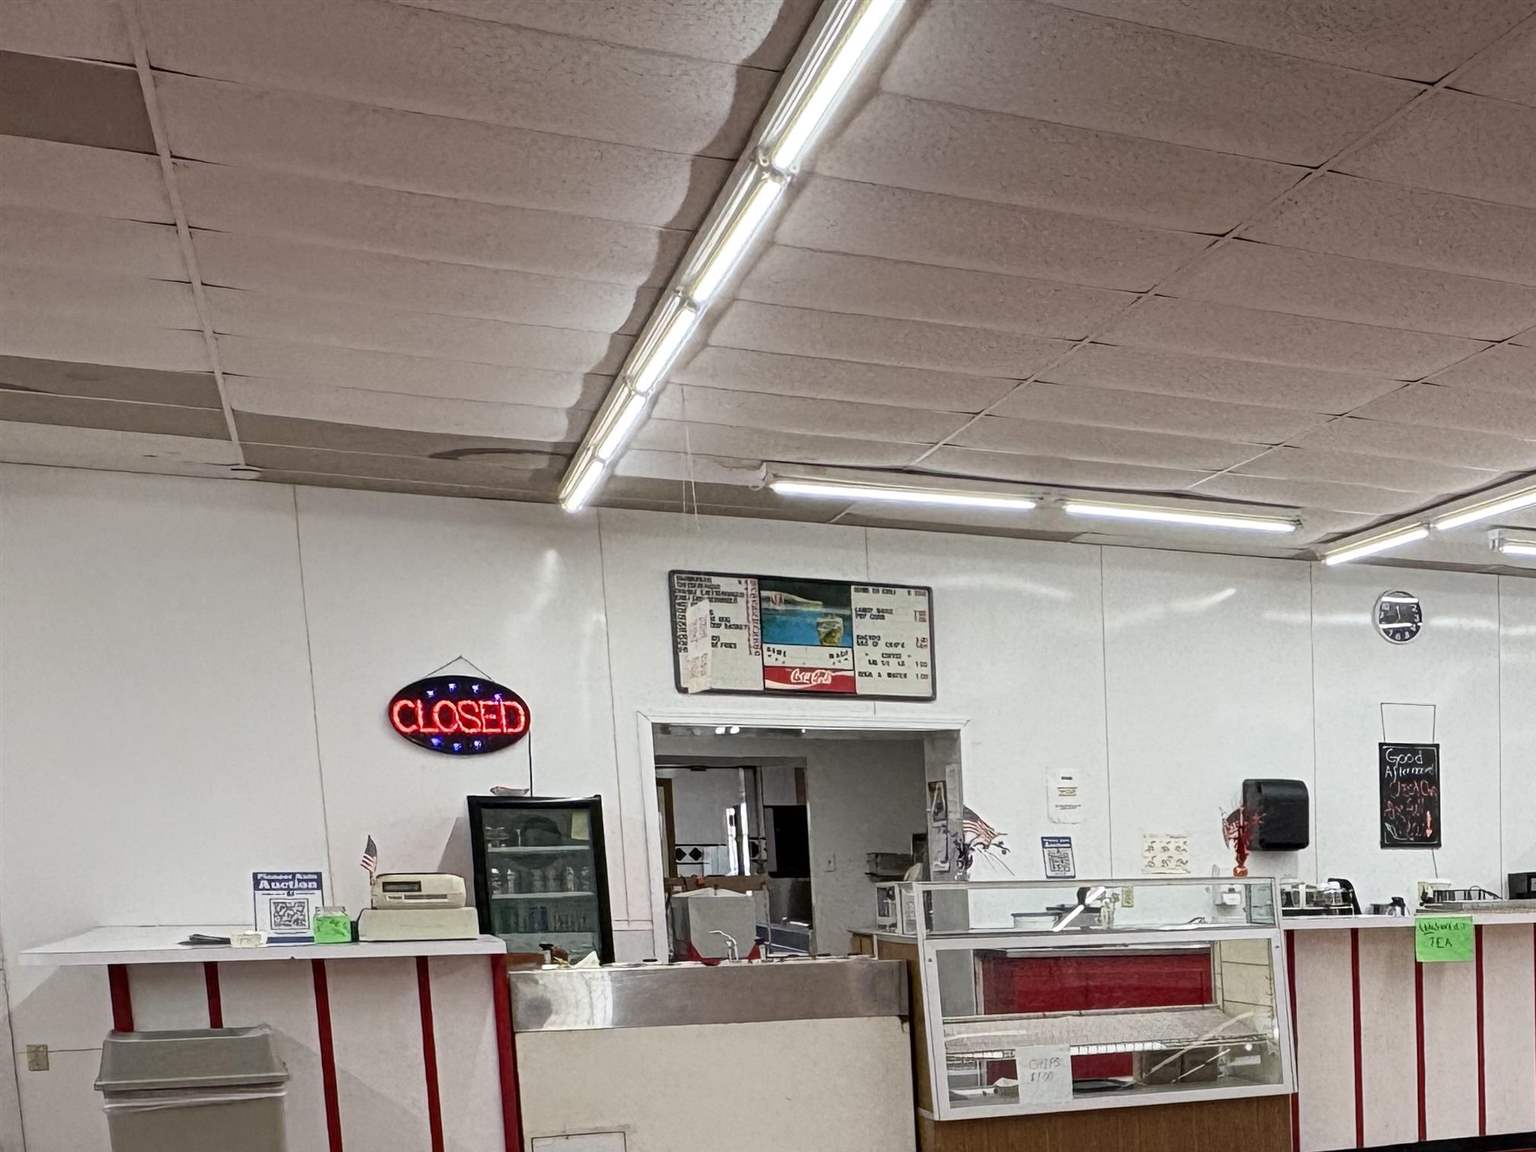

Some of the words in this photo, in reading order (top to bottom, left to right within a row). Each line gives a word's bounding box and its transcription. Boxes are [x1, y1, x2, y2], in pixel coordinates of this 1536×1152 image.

[393, 699, 525, 733] CLOSED
[1385, 748, 1423, 764] Good
[258, 880, 318, 889] Auction
[1429, 937, 1453, 949] TEA
